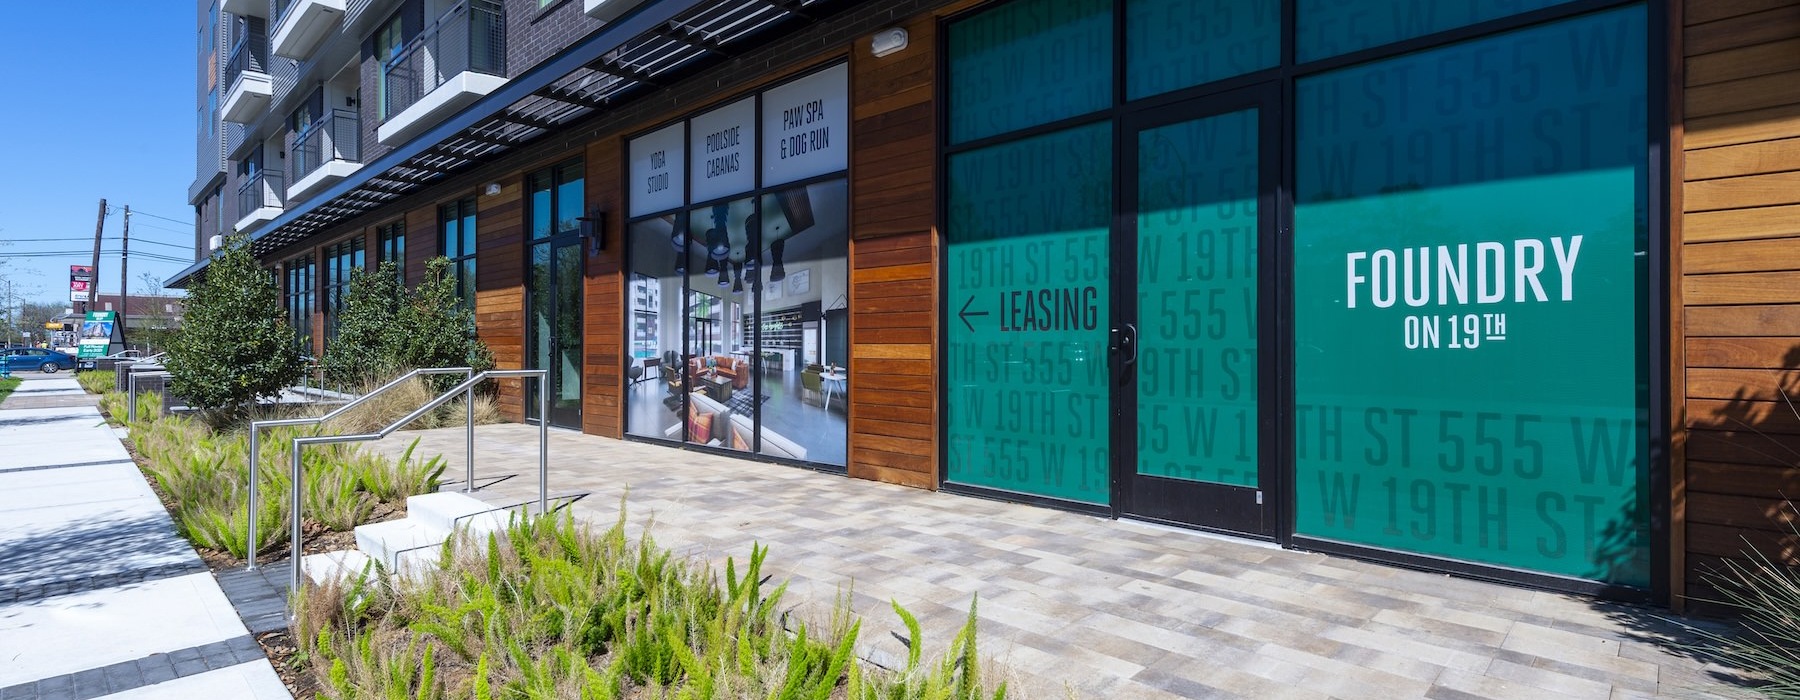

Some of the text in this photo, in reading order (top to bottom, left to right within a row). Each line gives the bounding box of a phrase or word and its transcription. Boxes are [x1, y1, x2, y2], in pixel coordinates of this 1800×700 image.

[1002, 50, 1025, 97] W
[1037, 26, 1103, 88] 19TH
[1362, 62, 1416, 128] ST
[1435, 37, 1541, 116] 555
[1568, 18, 1628, 92] W
[706, 126, 740, 154] POOLSIDE
[784, 99, 824, 131] PAW SPA
[650, 150, 666, 170] YOGA
[706, 152, 740, 179] CABANAS
[780, 126, 829, 160] & DOG RUN
[995, 141, 1056, 191] 19TH
[1380, 117, 1505, 190] 19TH
[1533, 102, 1600, 174] ST
[647, 172, 669, 194] STUDIO
[959, 244, 1014, 289] 19TH
[1025, 241, 1054, 285] ST
[1347, 235, 1583, 308] FOUNDRY
[1000, 286, 1097, 331] LEASING
[1160, 287, 1226, 340] 555
[1404, 313, 1506, 349] ON 19TH
[951, 342, 976, 381] TH
[986, 341, 1013, 383] ST
[1022, 341, 1072, 385] 555
[1141, 347, 1204, 399] 9TH
[963, 389, 984, 428] W
[995, 390, 1056, 435] 19TH
[1068, 393, 1099, 439] ST
[1183, 405, 1217, 458] W
[1234, 409, 1251, 462] 1
[950, 433, 975, 475] ST
[984, 437, 1029, 483] 555
[1041, 442, 1066, 487] W
[1078, 445, 1108, 494] 19
[1296, 404, 1632, 486] TH ST 555 W
[1318, 469, 1605, 572] W 19TH ST
